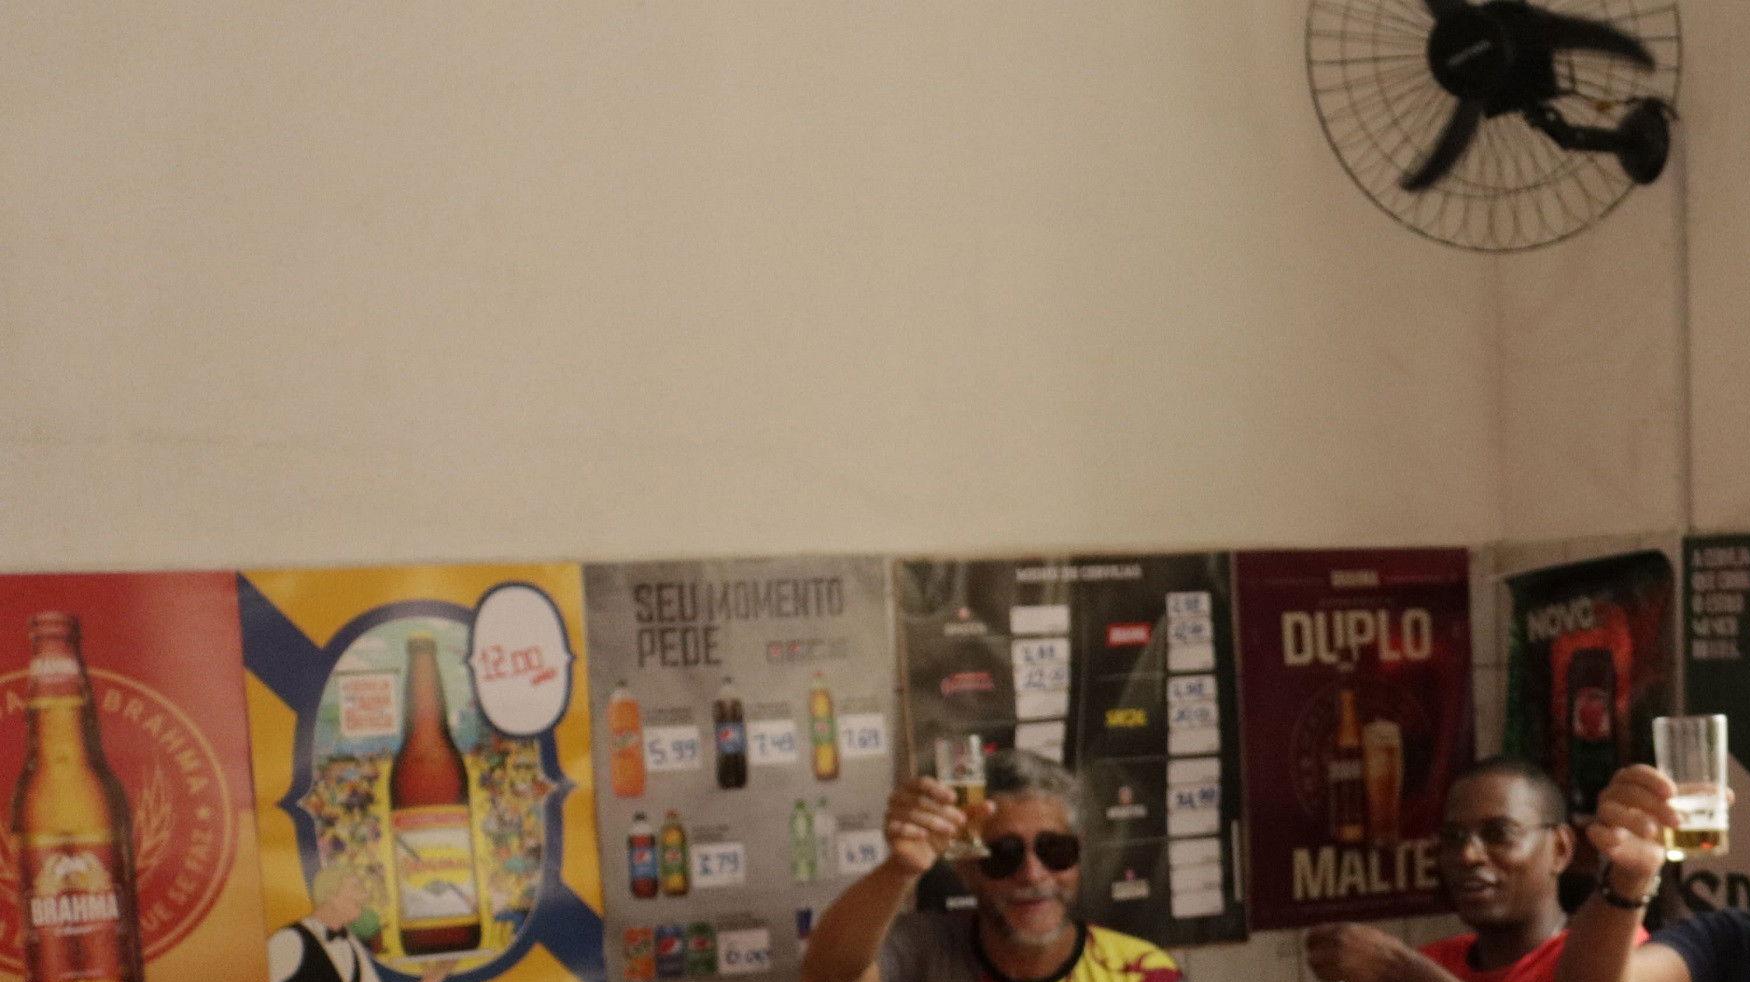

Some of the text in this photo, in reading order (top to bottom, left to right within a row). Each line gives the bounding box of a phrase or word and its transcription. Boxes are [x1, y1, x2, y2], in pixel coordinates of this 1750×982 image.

[634, 577, 844, 623] SEU MOMENTO
[1526, 596, 1600, 641] NOVO
[637, 625, 721, 668] PEDE
[1281, 607, 1433, 666] DUPLO
[103, 688, 209, 794] BRAHMA
[1291, 838, 1441, 900] MALTE
[31, 893, 119, 927] BRAHMA
